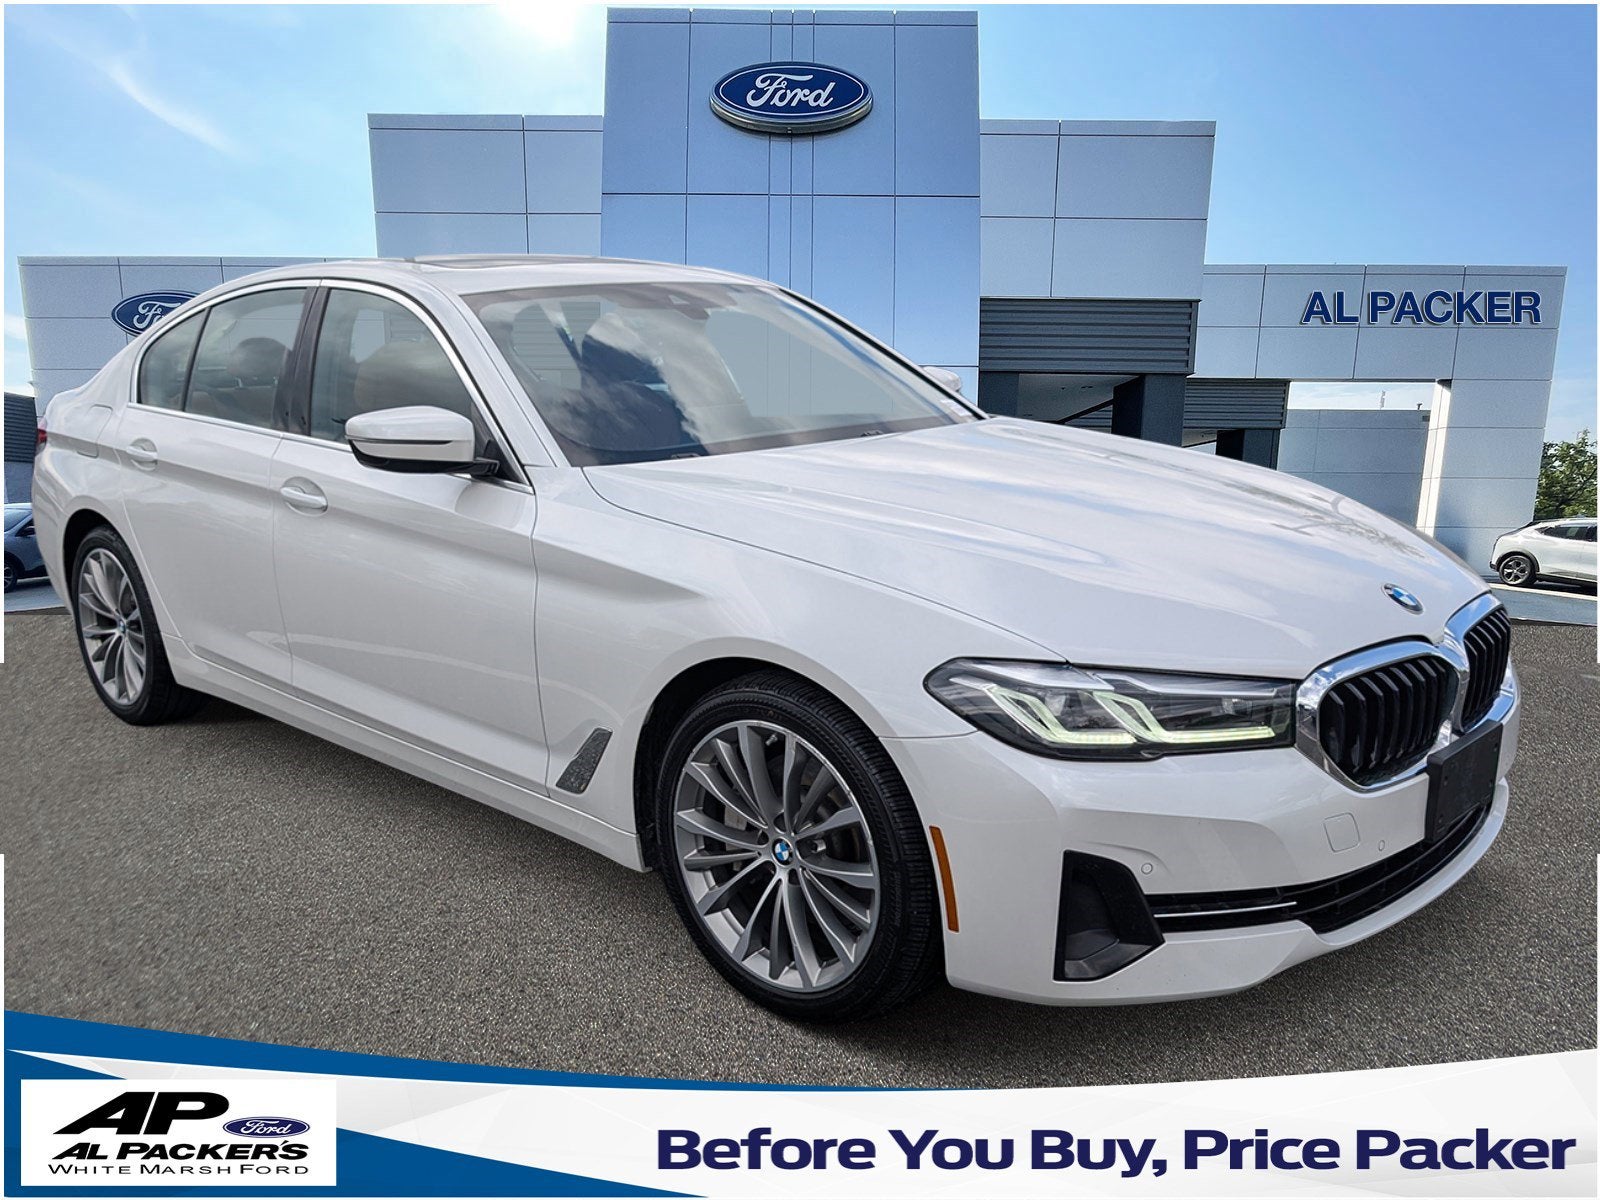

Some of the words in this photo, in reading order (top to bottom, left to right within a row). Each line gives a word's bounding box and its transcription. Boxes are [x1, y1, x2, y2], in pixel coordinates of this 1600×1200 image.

[747, 73, 836, 107] Ford
[1302, 291, 1359, 323] AL
[1368, 290, 1542, 324] PACKER
